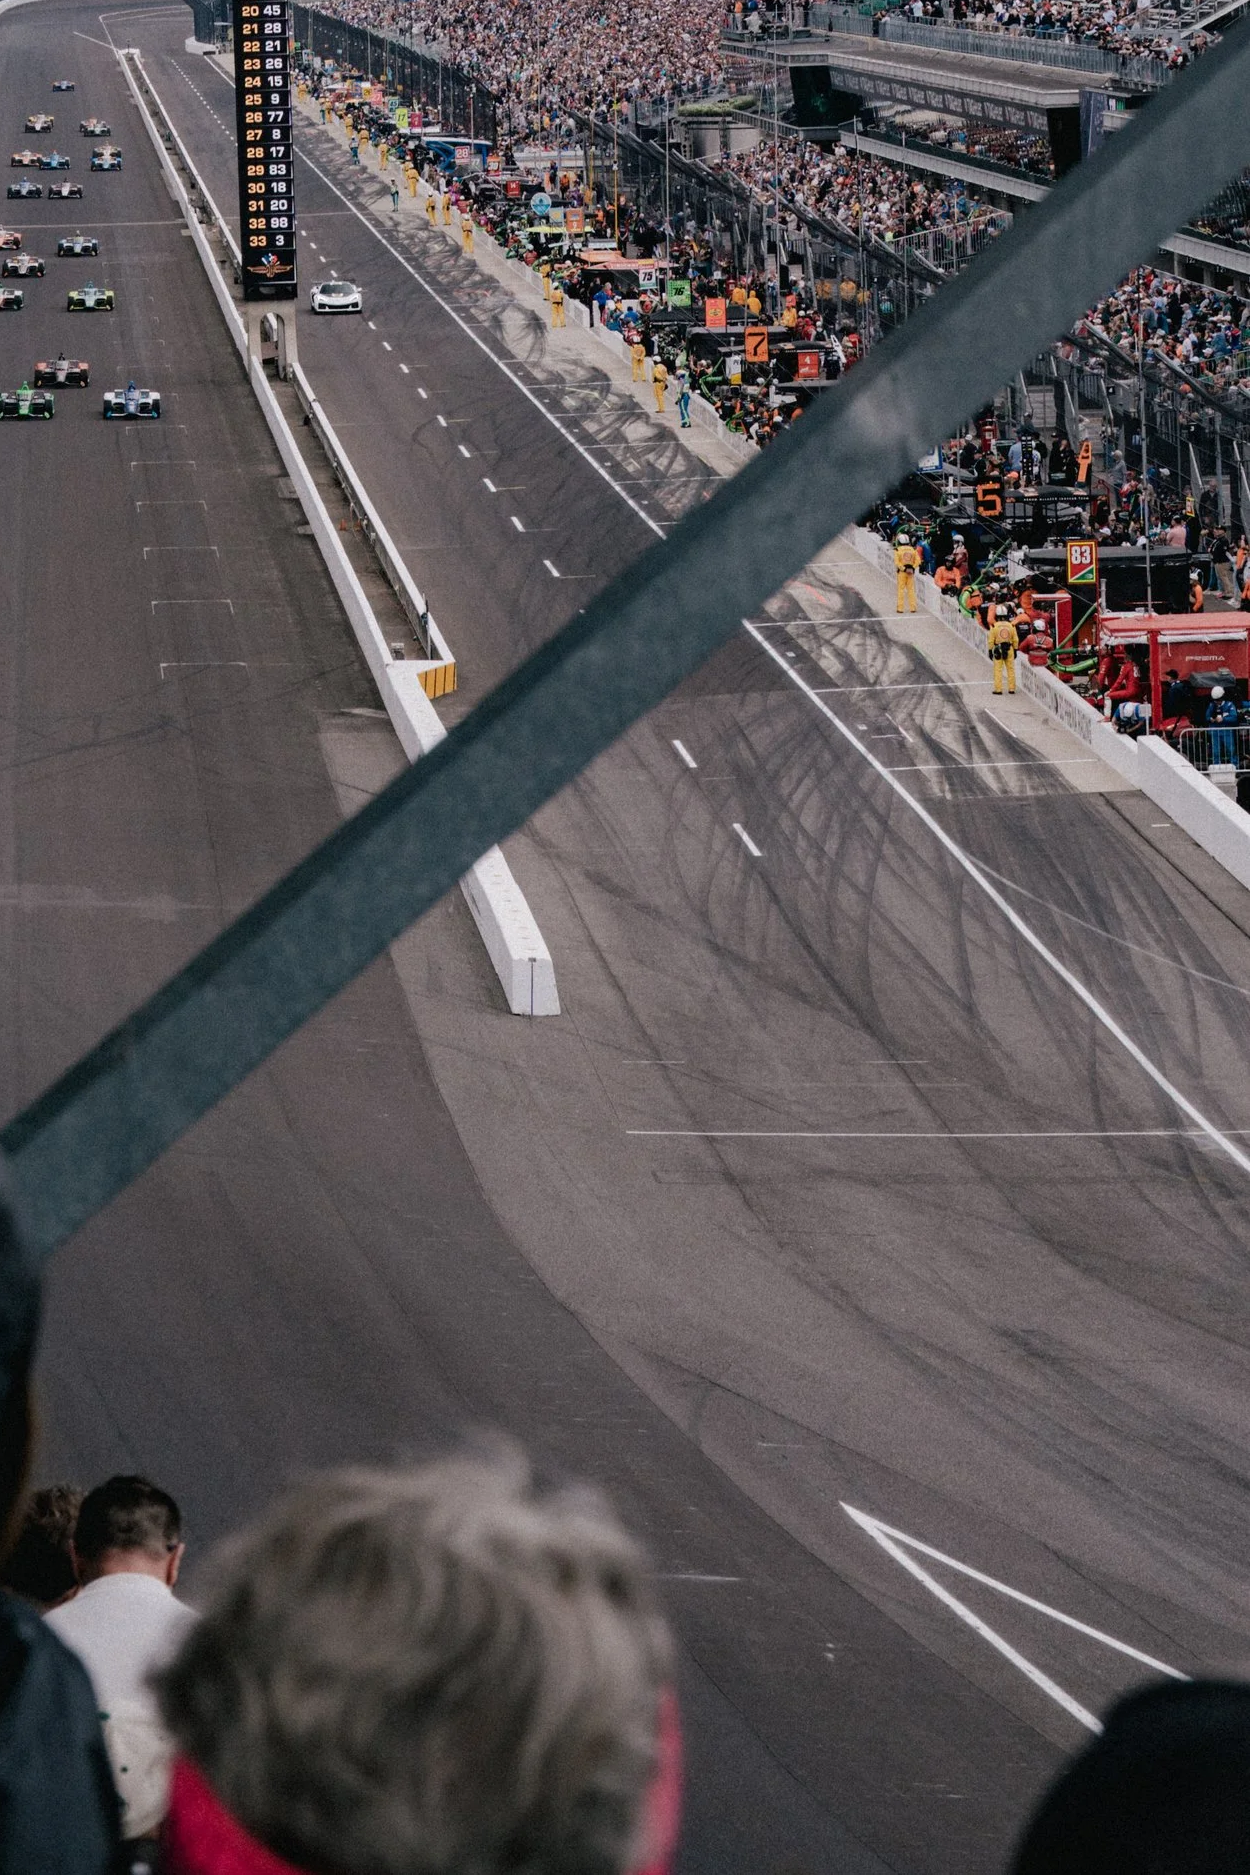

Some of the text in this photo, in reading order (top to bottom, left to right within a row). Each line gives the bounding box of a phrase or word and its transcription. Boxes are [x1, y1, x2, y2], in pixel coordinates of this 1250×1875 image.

[241, 5, 281, 17] 20 45
[242, 22, 282, 35] 21 28
[242, 40, 281, 53] 22 21
[243, 58, 283, 71] 23 26
[244, 76, 283, 88] 24 15
[244, 94, 280, 106] 25 9
[245, 111, 284, 124] 26 77
[246, 129, 281, 141] 27 8
[246, 147, 285, 159] 28 17
[456, 148, 469, 158] 28
[247, 164, 287, 177] 29 83
[247, 182, 287, 194] 30 18
[248, 200, 288, 212] 31 20
[248, 218, 267, 230] 32
[249, 235, 285, 247] 33 3
[641, 271, 653, 282] 75
[672, 287, 686, 296] 76
[747, 331, 766, 357] 7
[976, 481, 1002, 517] 5
[1070, 546, 1092, 564] 83
